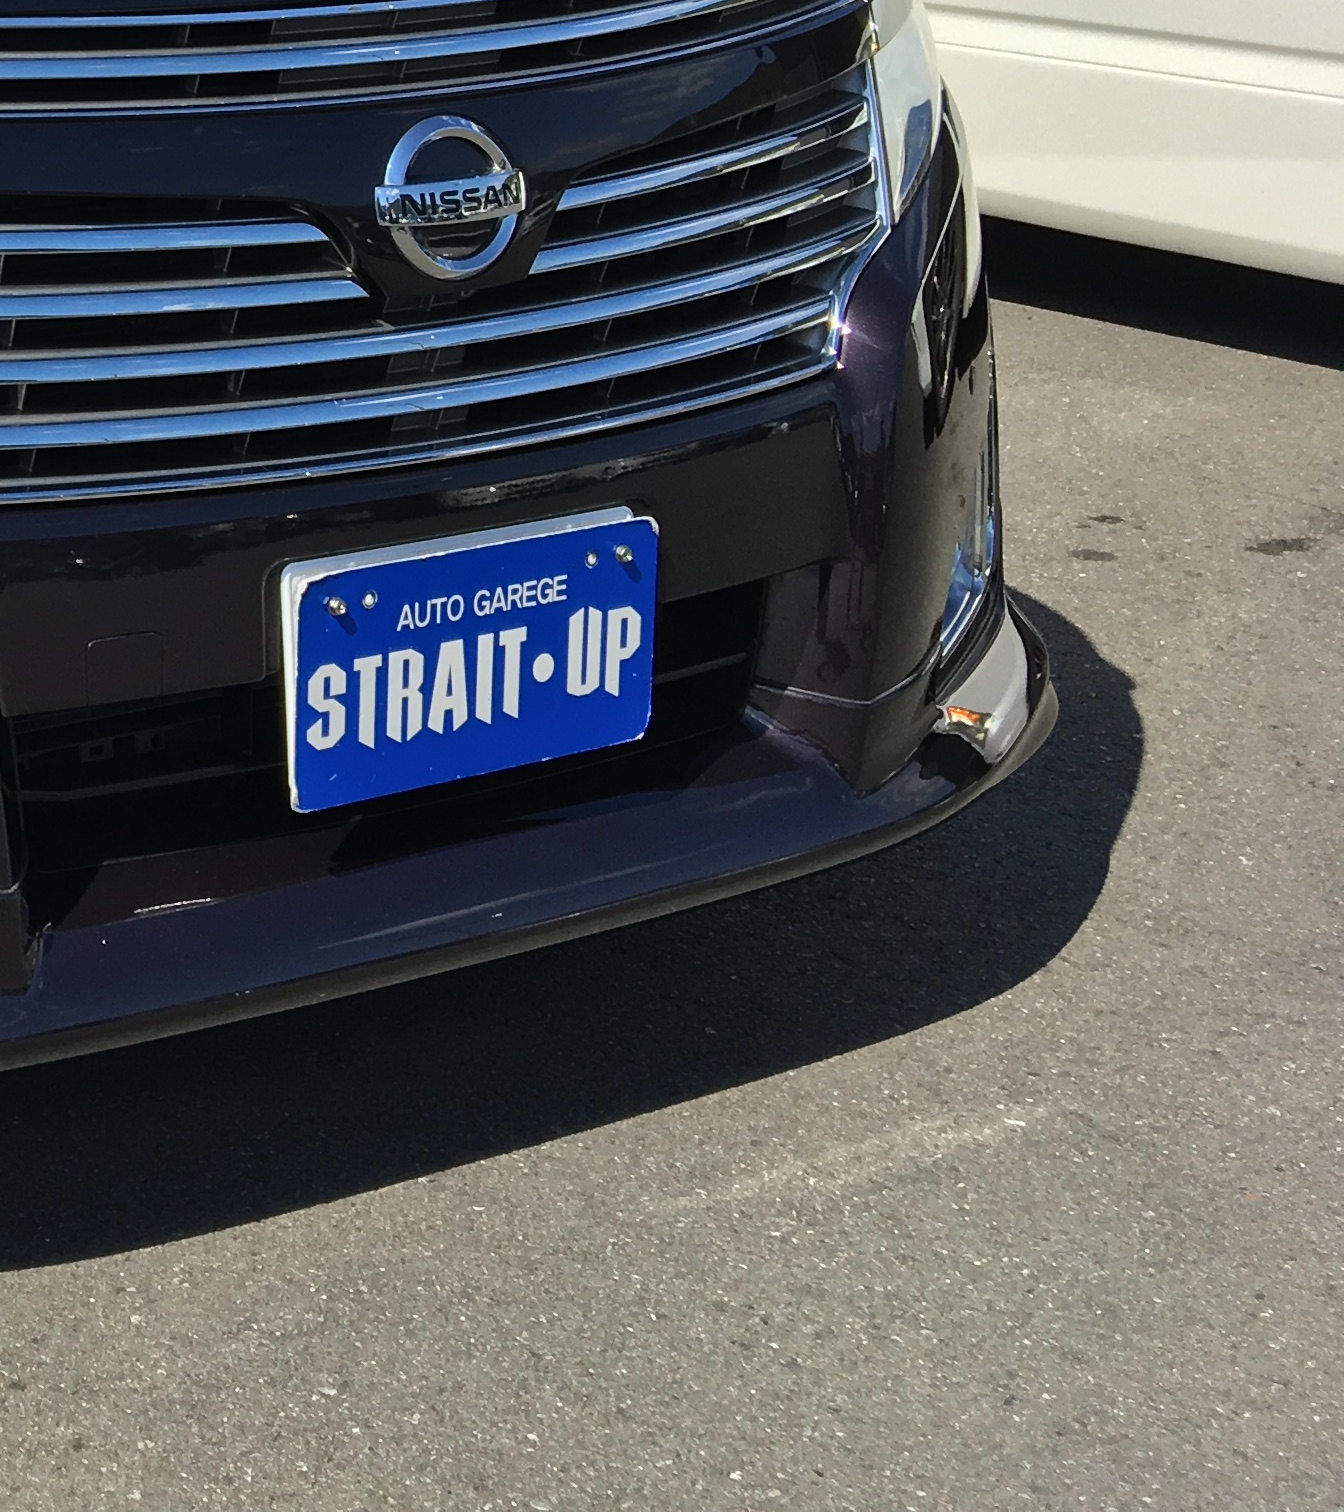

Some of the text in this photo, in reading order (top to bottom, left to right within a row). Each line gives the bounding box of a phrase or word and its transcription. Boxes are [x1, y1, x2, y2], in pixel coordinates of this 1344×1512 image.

[399, 181, 520, 217] NISSAN
[397, 574, 568, 632] AUTO GAREGE
